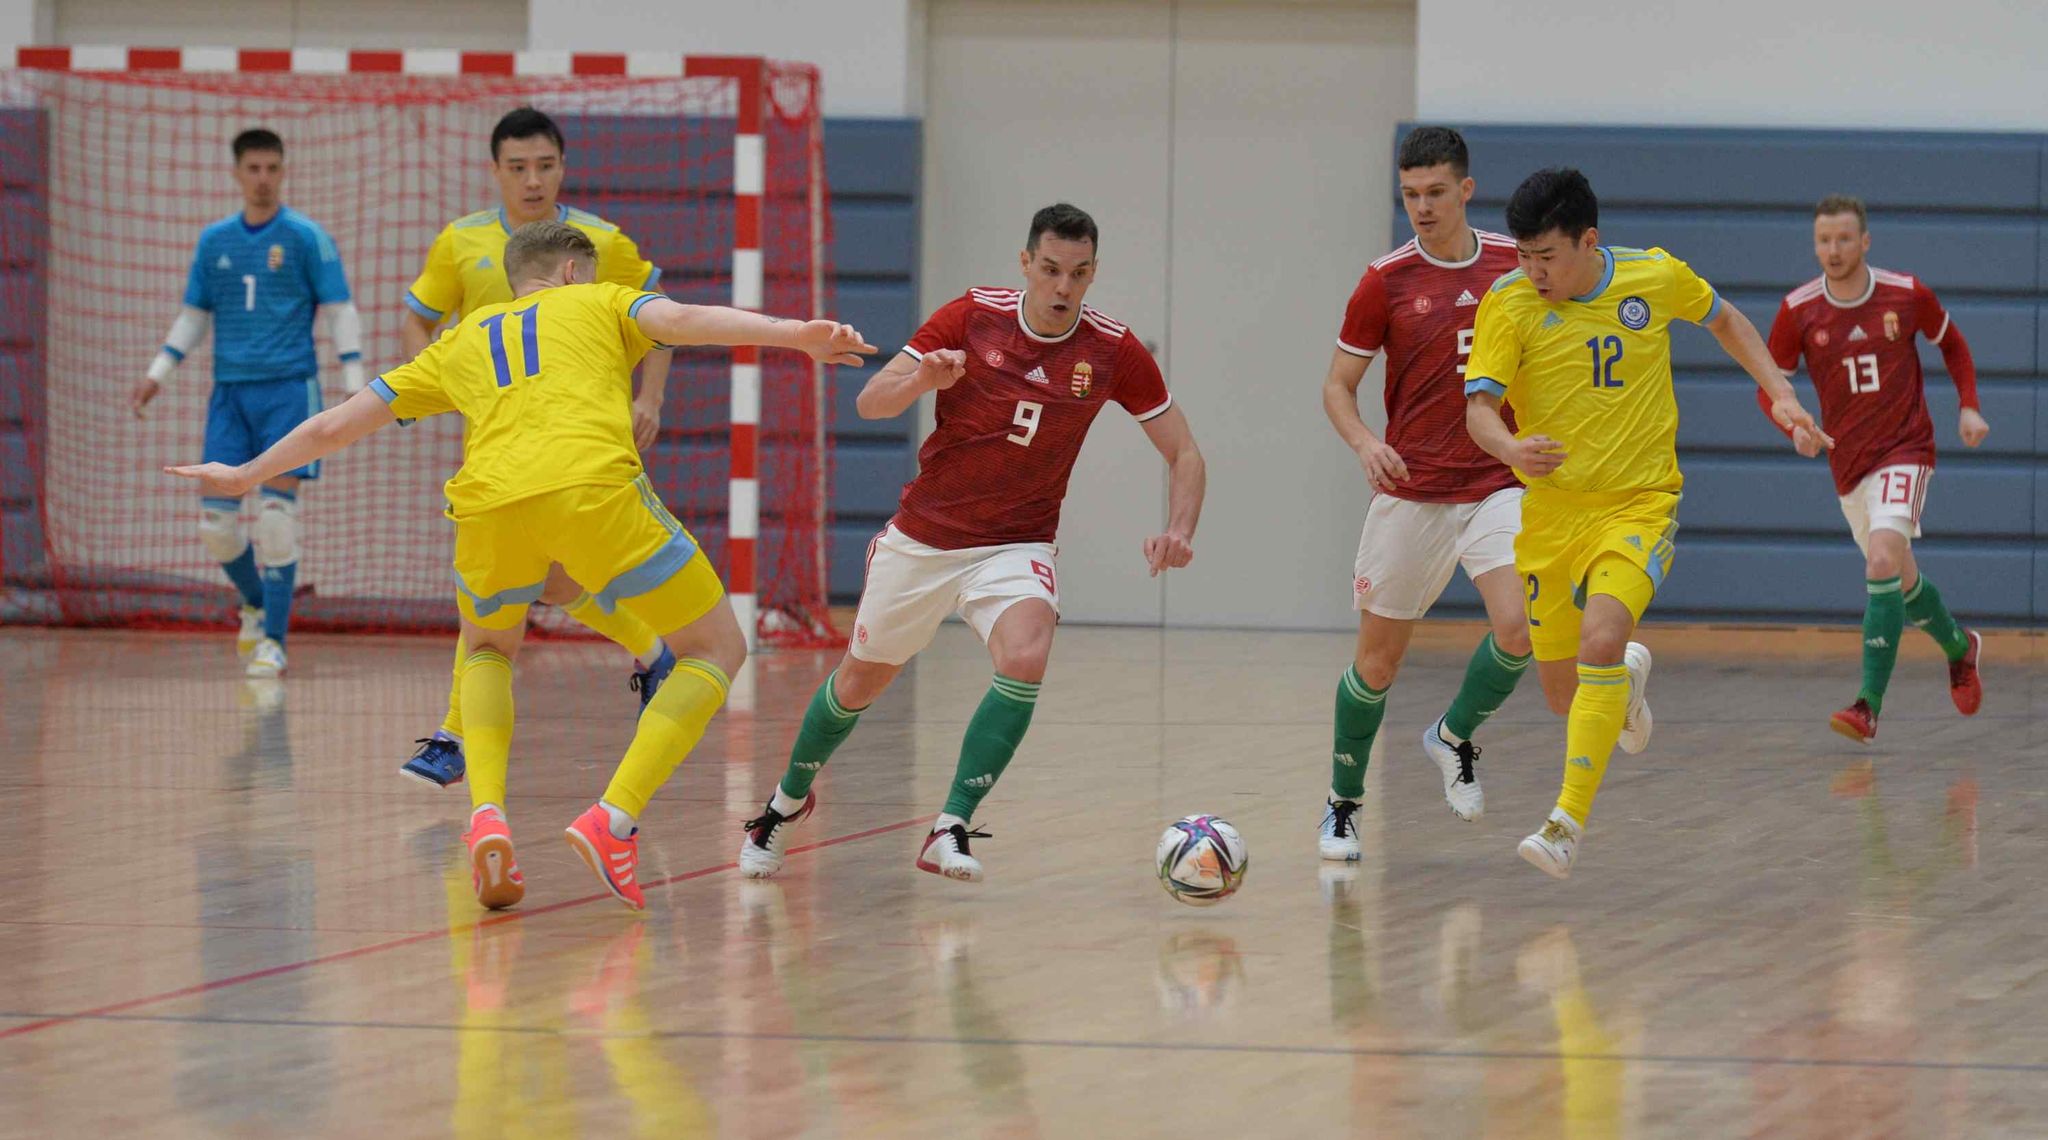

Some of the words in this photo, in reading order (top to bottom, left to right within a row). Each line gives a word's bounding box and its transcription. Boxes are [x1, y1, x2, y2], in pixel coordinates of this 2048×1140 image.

[242, 274, 256, 311] 1
[479, 302, 540, 387] 11
[1586, 335, 1624, 388] 12
[1842, 354, 1880, 394] 13
[1006, 400, 1044, 447] 9
[1881, 472, 1911, 504] 13
[1031, 560, 1055, 596] 9
